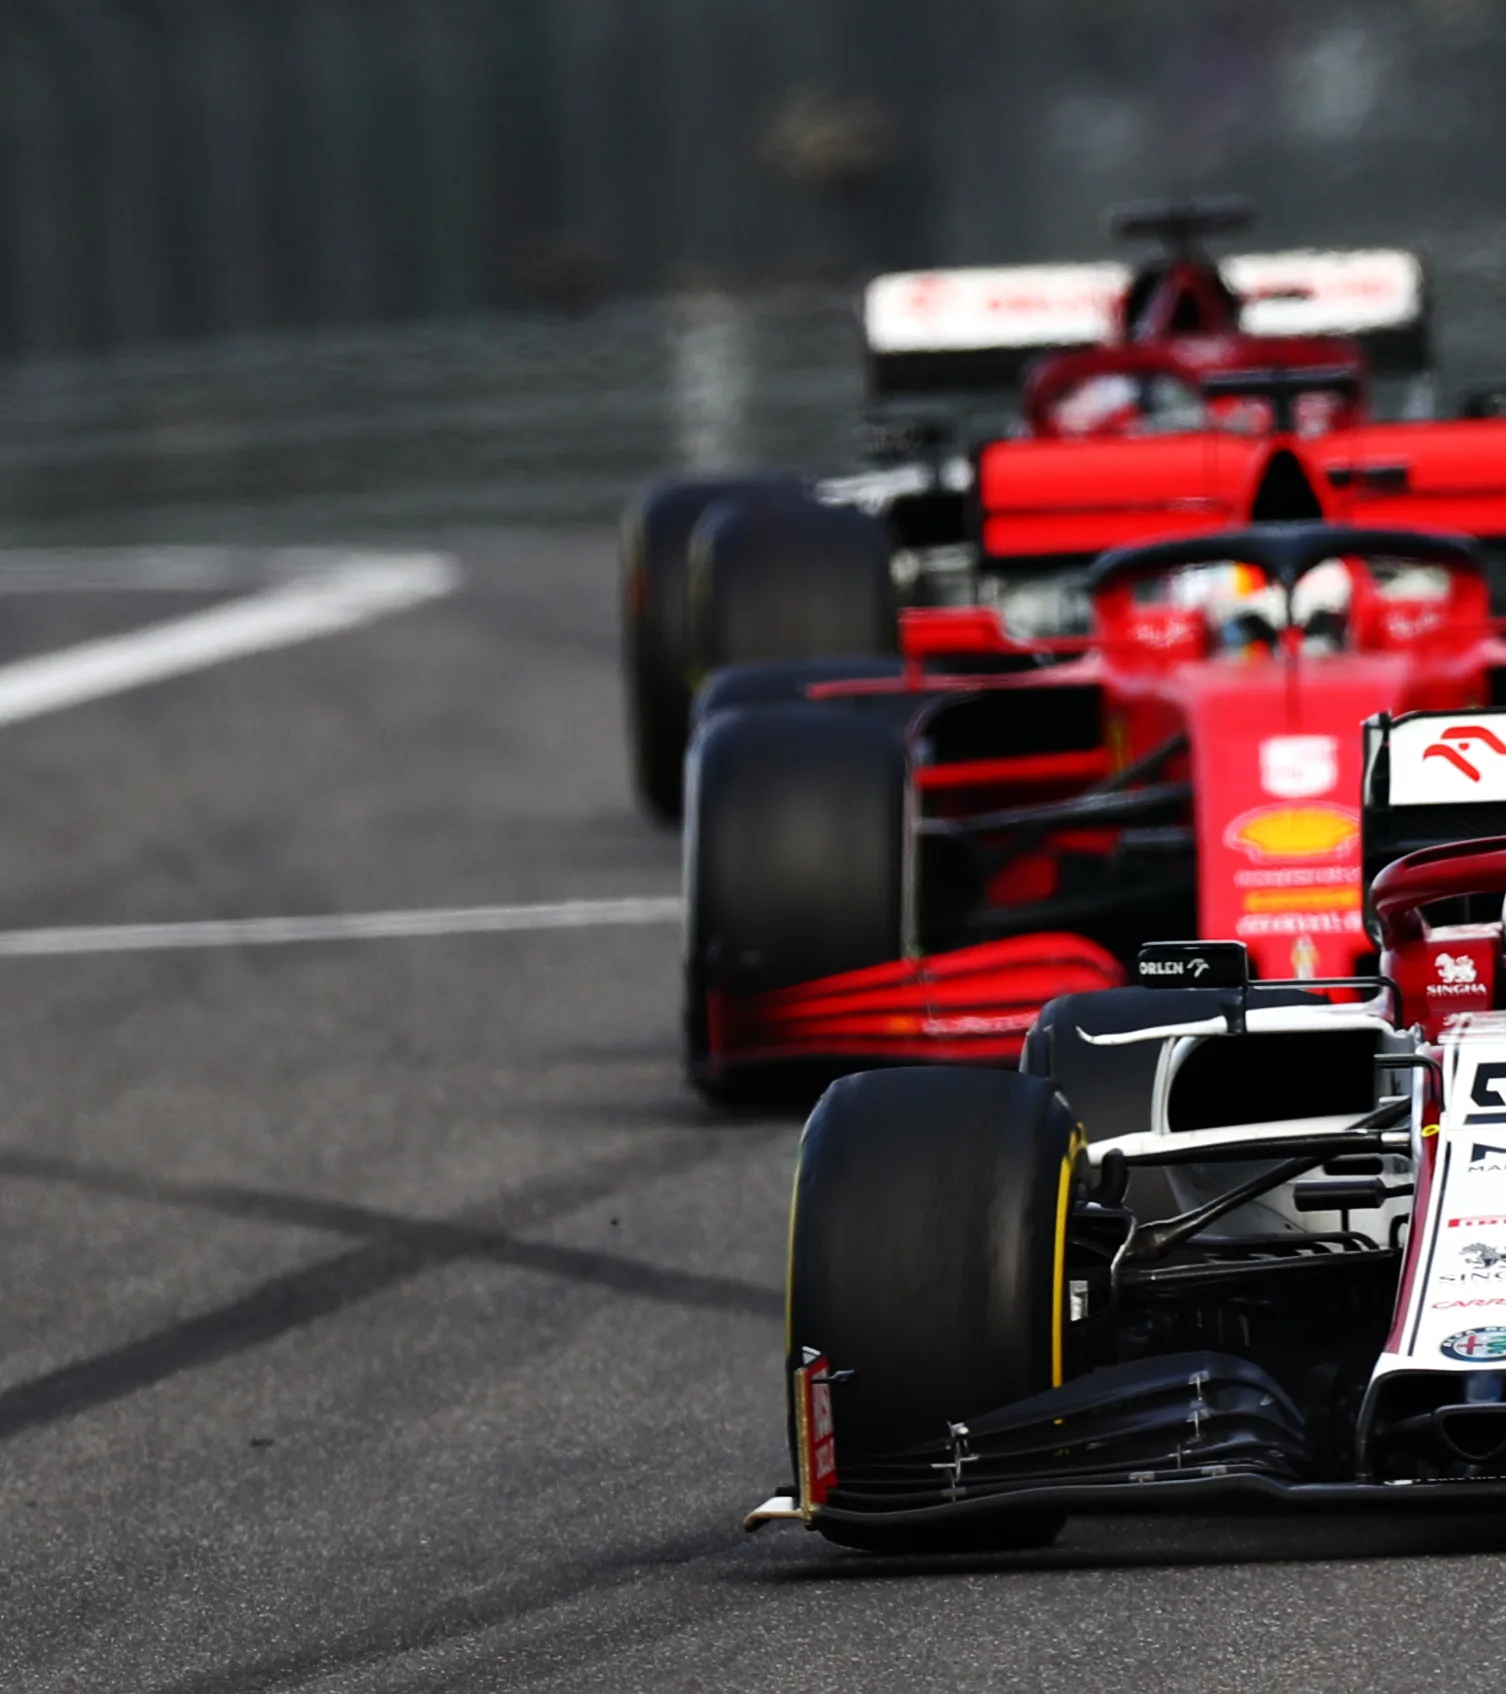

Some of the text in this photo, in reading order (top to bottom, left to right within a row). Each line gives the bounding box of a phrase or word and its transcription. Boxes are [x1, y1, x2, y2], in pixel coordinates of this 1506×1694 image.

[1260, 735, 1337, 798] 5
[1139, 961, 1184, 975] ORLEN
[1426, 983, 1487, 994] SINGHA
